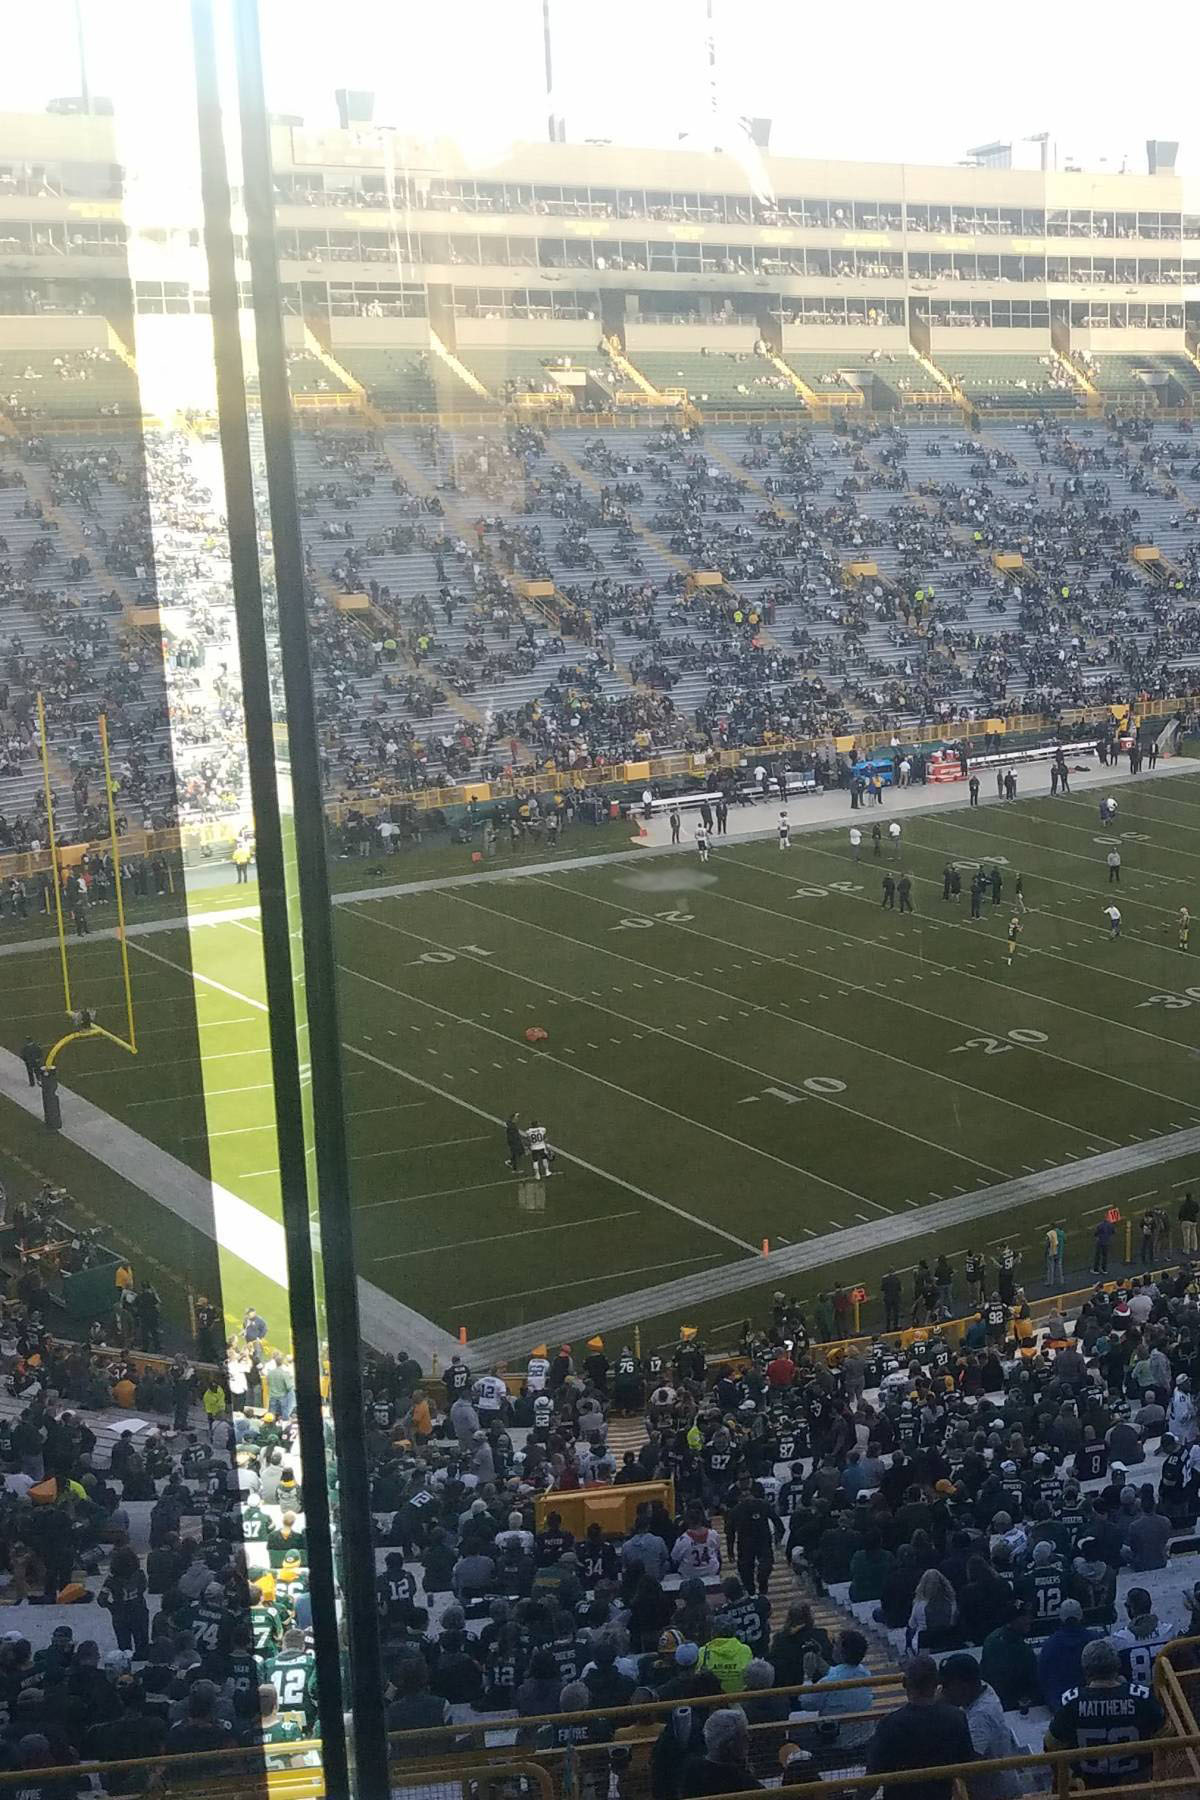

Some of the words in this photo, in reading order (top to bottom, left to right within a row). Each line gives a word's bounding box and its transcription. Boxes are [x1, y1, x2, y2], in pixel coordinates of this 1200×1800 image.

[619, 910, 695, 930] 20
[420, 944, 495, 963] 10
[964, 1029, 1049, 1055] 20
[763, 1076, 848, 1104] 10
[530, 1132, 544, 1144] 80
[989, 1311, 1003, 1325] 92
[620, 1362, 635, 1374] 76
[650, 1360, 661, 1372] 17
[938, 1352, 949, 1366] 27
[454, 1373, 468, 1388] 87
[481, 1384, 496, 1399] 12
[779, 1443, 795, 1458] 87
[711, 1455, 731, 1470] 97
[1092, 1454, 1101, 1475] 8
[243, 1520, 262, 1538] 97
[691, 1549, 710, 1567] 34
[585, 1558, 604, 1577] 34
[389, 1580, 409, 1600] 12
[1036, 1588, 1061, 1618] 12
[192, 1620, 219, 1650] 74
[1130, 1646, 1152, 1683] 8
[495, 1666, 516, 1687] 12
[270, 1669, 306, 1705] 12
[1061, 1686, 1080, 1706] 2
[1129, 1683, 1152, 1699] 5
[1078, 1699, 1136, 1717] MATTHEWS
